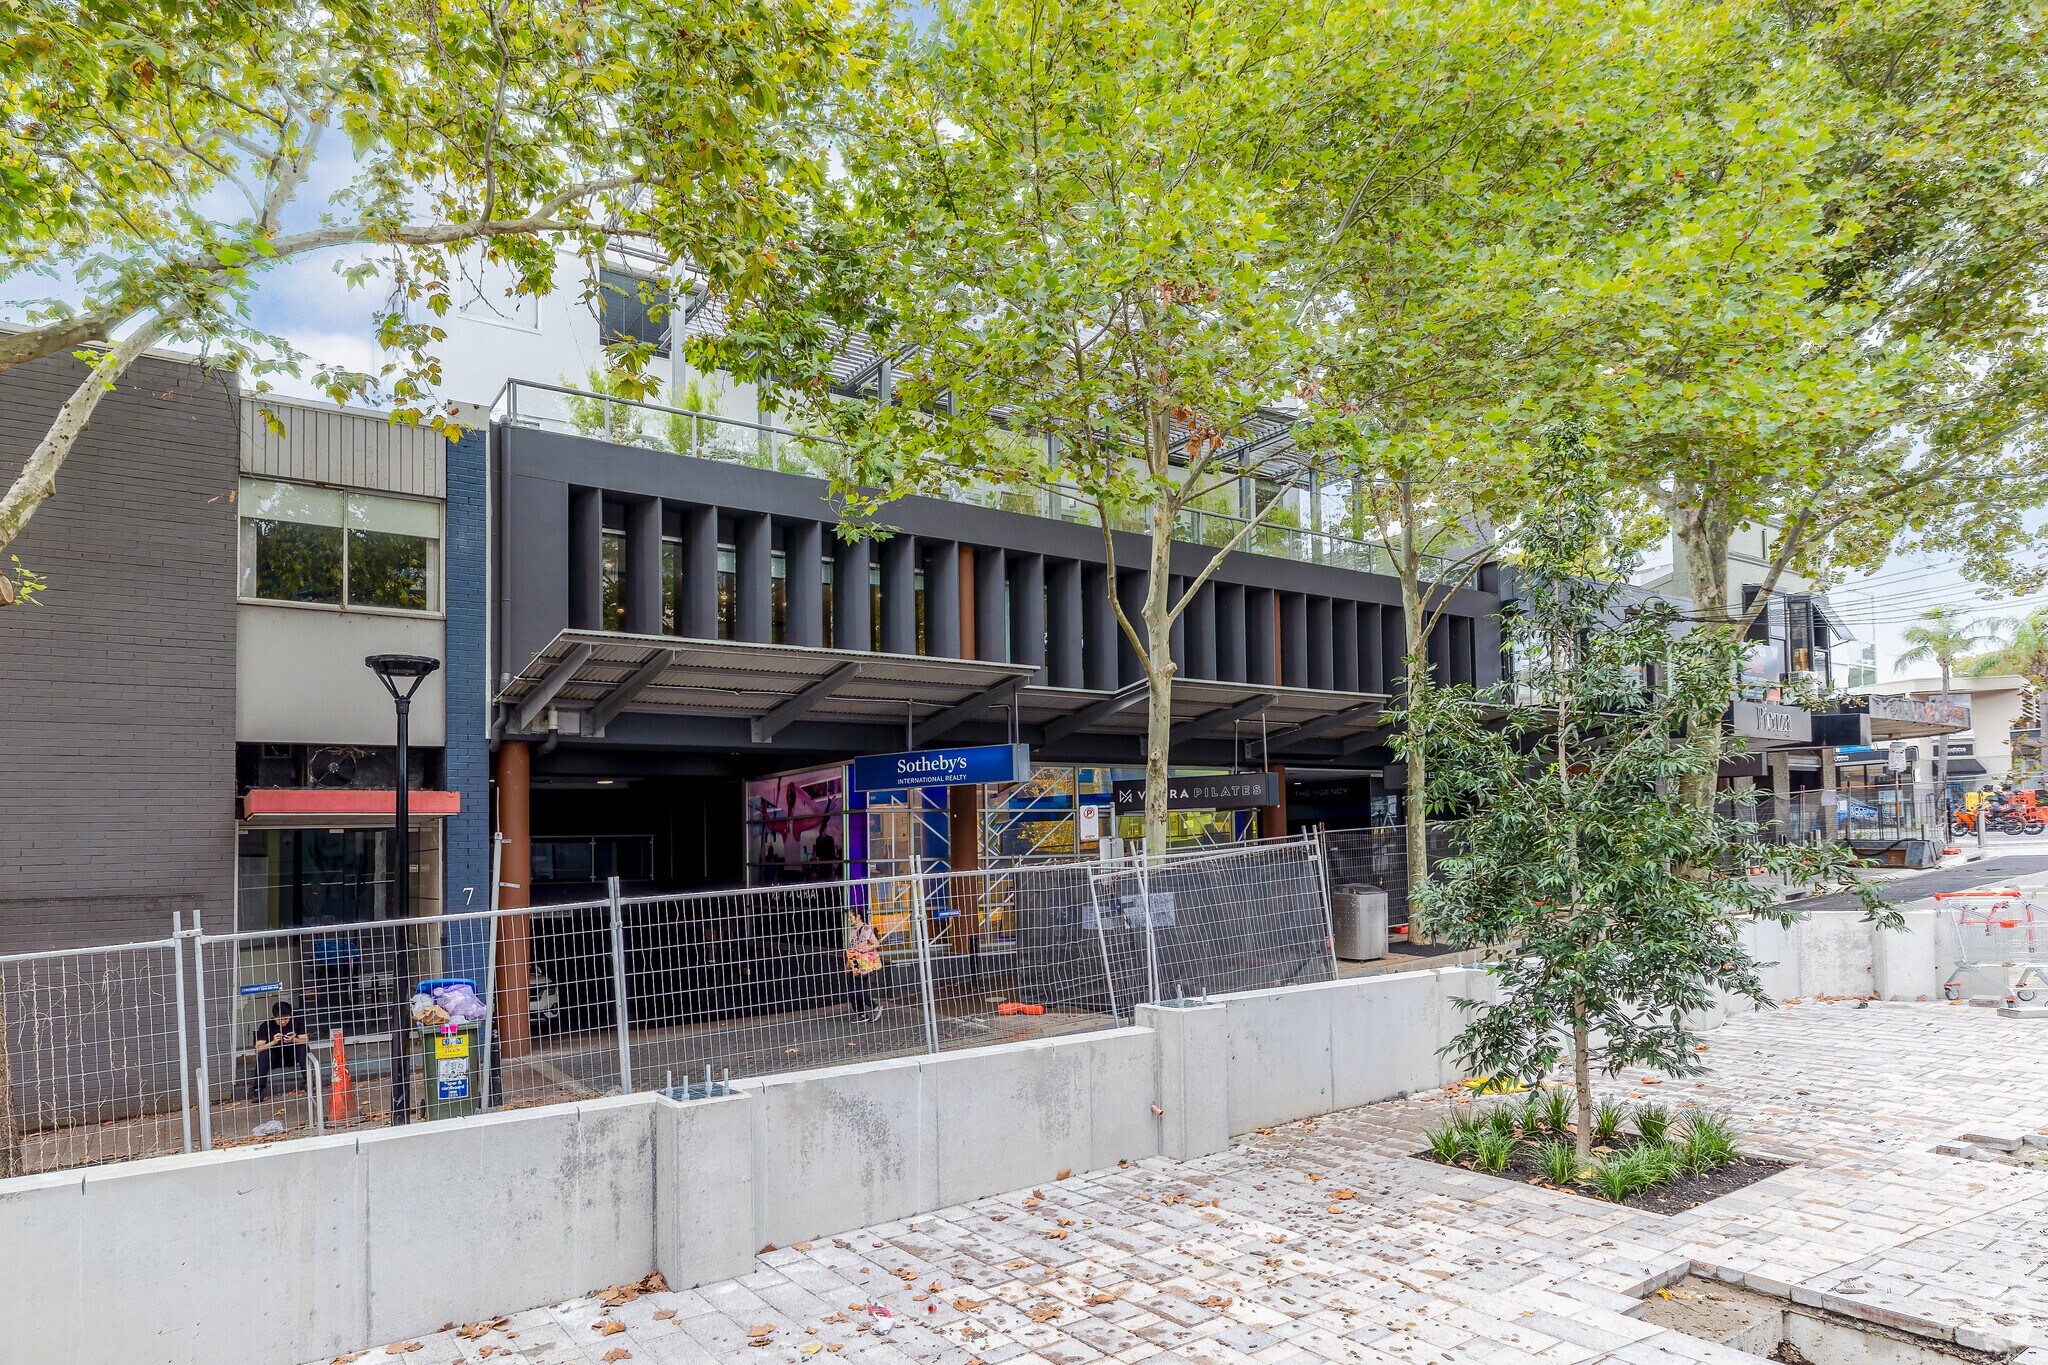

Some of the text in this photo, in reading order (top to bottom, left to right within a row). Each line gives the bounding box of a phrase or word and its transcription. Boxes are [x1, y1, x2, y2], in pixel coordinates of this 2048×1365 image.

[897, 754, 967, 773] Sotheby's
[897, 774, 967, 785] INTERNATIONAL REALTY
[1138, 784, 1262, 800] VRA PILATES
[462, 887, 474, 906] 7
